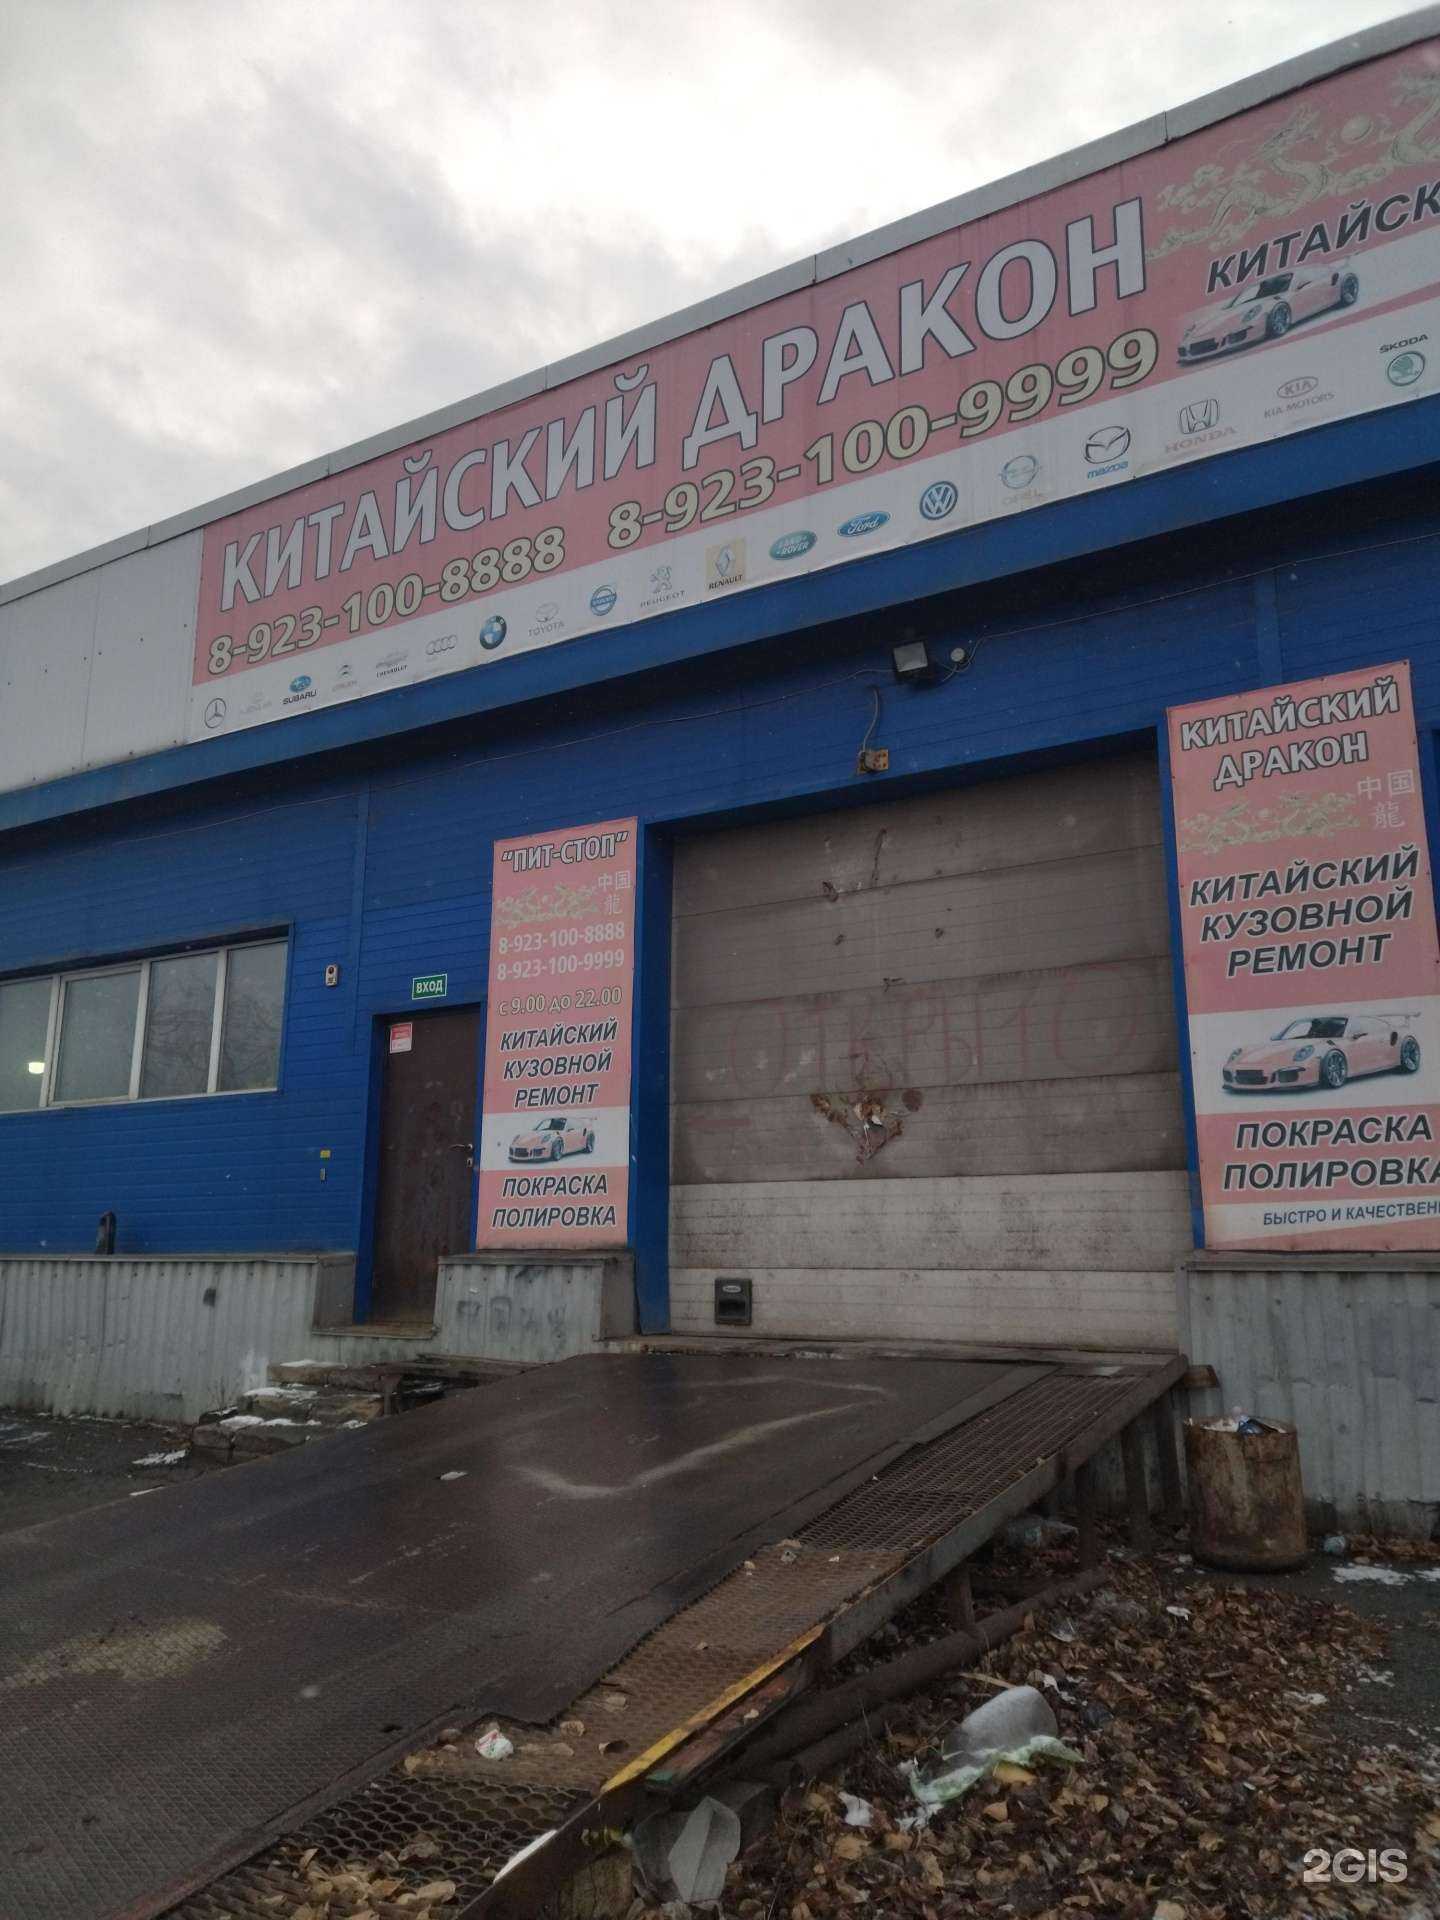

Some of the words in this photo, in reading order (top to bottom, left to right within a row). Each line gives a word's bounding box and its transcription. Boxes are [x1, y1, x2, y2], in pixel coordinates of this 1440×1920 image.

[1207, 180, 1440, 295] КИТАЙСК
[219, 363, 657, 612] КИТАЙСКИЙ
[682, 196, 1147, 471] ДРАКОН
[607, 328, 1160, 550] 8-923-100-9999
[708, 574, 743, 591] RENAULT
[207, 526, 565, 676] 8-923-100-8888
[528, 621, 565, 638] TOYOTA
[282, 689, 318, 705] SUBARU
[1181, 675, 1401, 751] КИТАЙСКИЙ
[1213, 731, 1369, 791] ДРАКОН
[1190, 844, 1420, 907] КИТАЙСКИЙ
[1201, 885, 1413, 943] КУЗОВНОЙ
[498, 921, 625, 955] 8-923-100-8888
[1227, 933, 1392, 977] РЕМОНТ
[497, 949, 625, 981] 8-923-100-9999
[416, 979, 443, 995] ВХОД
[510, 994, 546, 1016] 9.00
[549, 996, 572, 1014] до
[575, 986, 623, 1009] 22.00
[500, 1017, 618, 1051] КИТАЙСКИЙ
[503, 1048, 613, 1080] КУЗОВНОЙ
[514, 1083, 600, 1108] РЕМОНТ
[1236, 1113, 1433, 1149] ПОКРАСКА
[502, 1174, 609, 1197] ПОКРАСКА
[492, 1205, 617, 1228] ПОЛИРОВКА
[1263, 1208, 1328, 1226] БЫСТРО
[1331, 1207, 1342, 1221] И
[1346, 1201, 1440, 1220] КАЧЕСТВЕН
